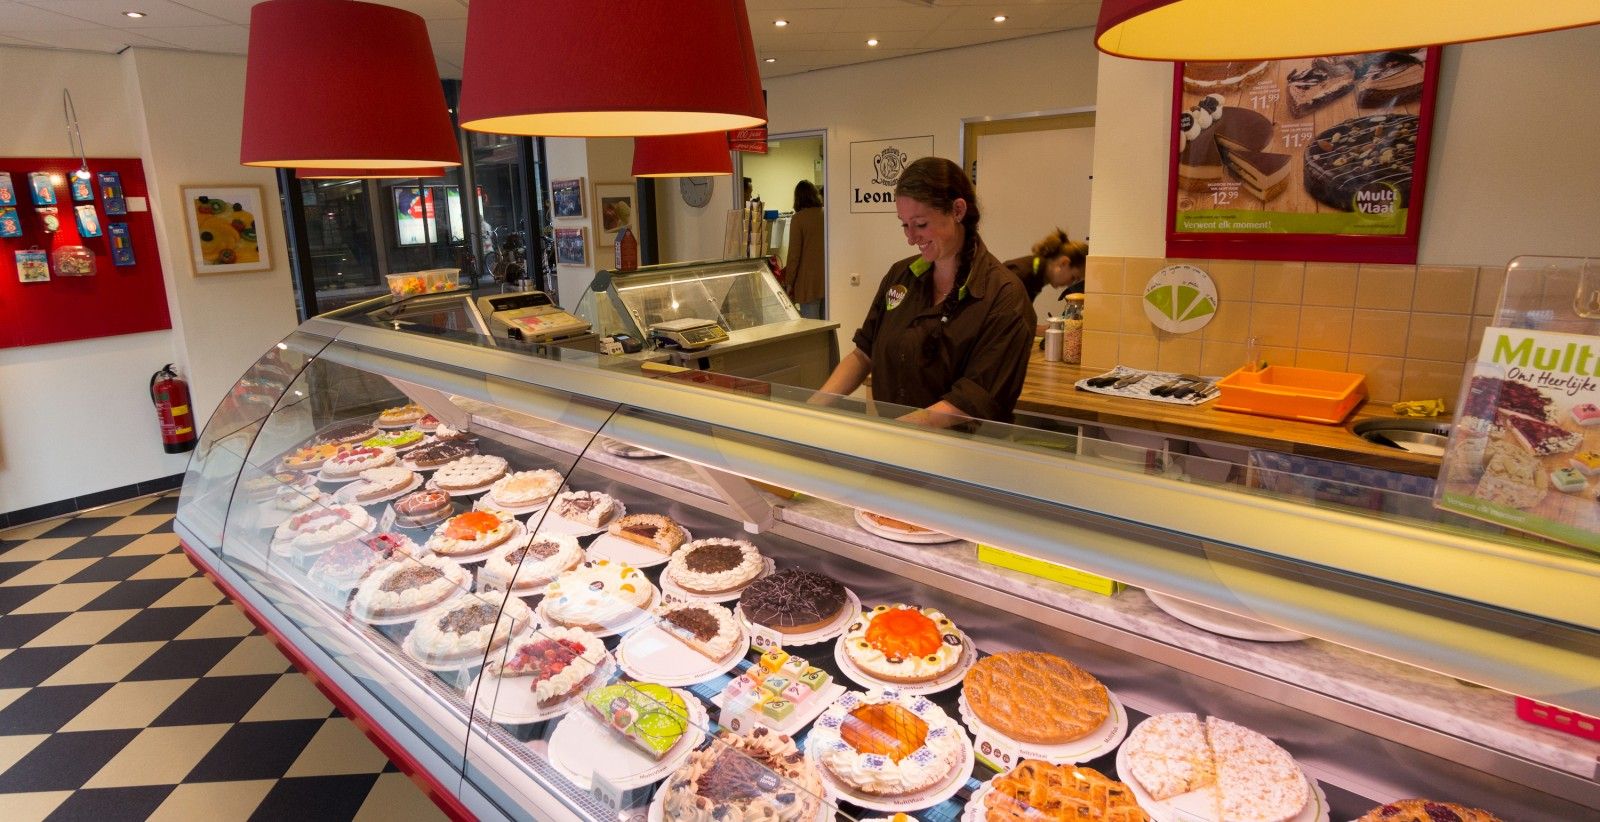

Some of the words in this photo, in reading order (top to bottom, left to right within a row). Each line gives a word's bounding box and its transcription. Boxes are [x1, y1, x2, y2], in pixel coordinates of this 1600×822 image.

[1282, 132, 1312, 148] 11.99
[1356, 189, 1397, 202] Multi
[1357, 202, 1394, 214] Vlaai
[1184, 221, 1216, 229] Verwent
[1218, 220, 1231, 229] elk
[1233, 221, 1271, 229] moment!
[1507, 367, 1535, 383] Ons
[1537, 371, 1597, 397] Heerlijke
